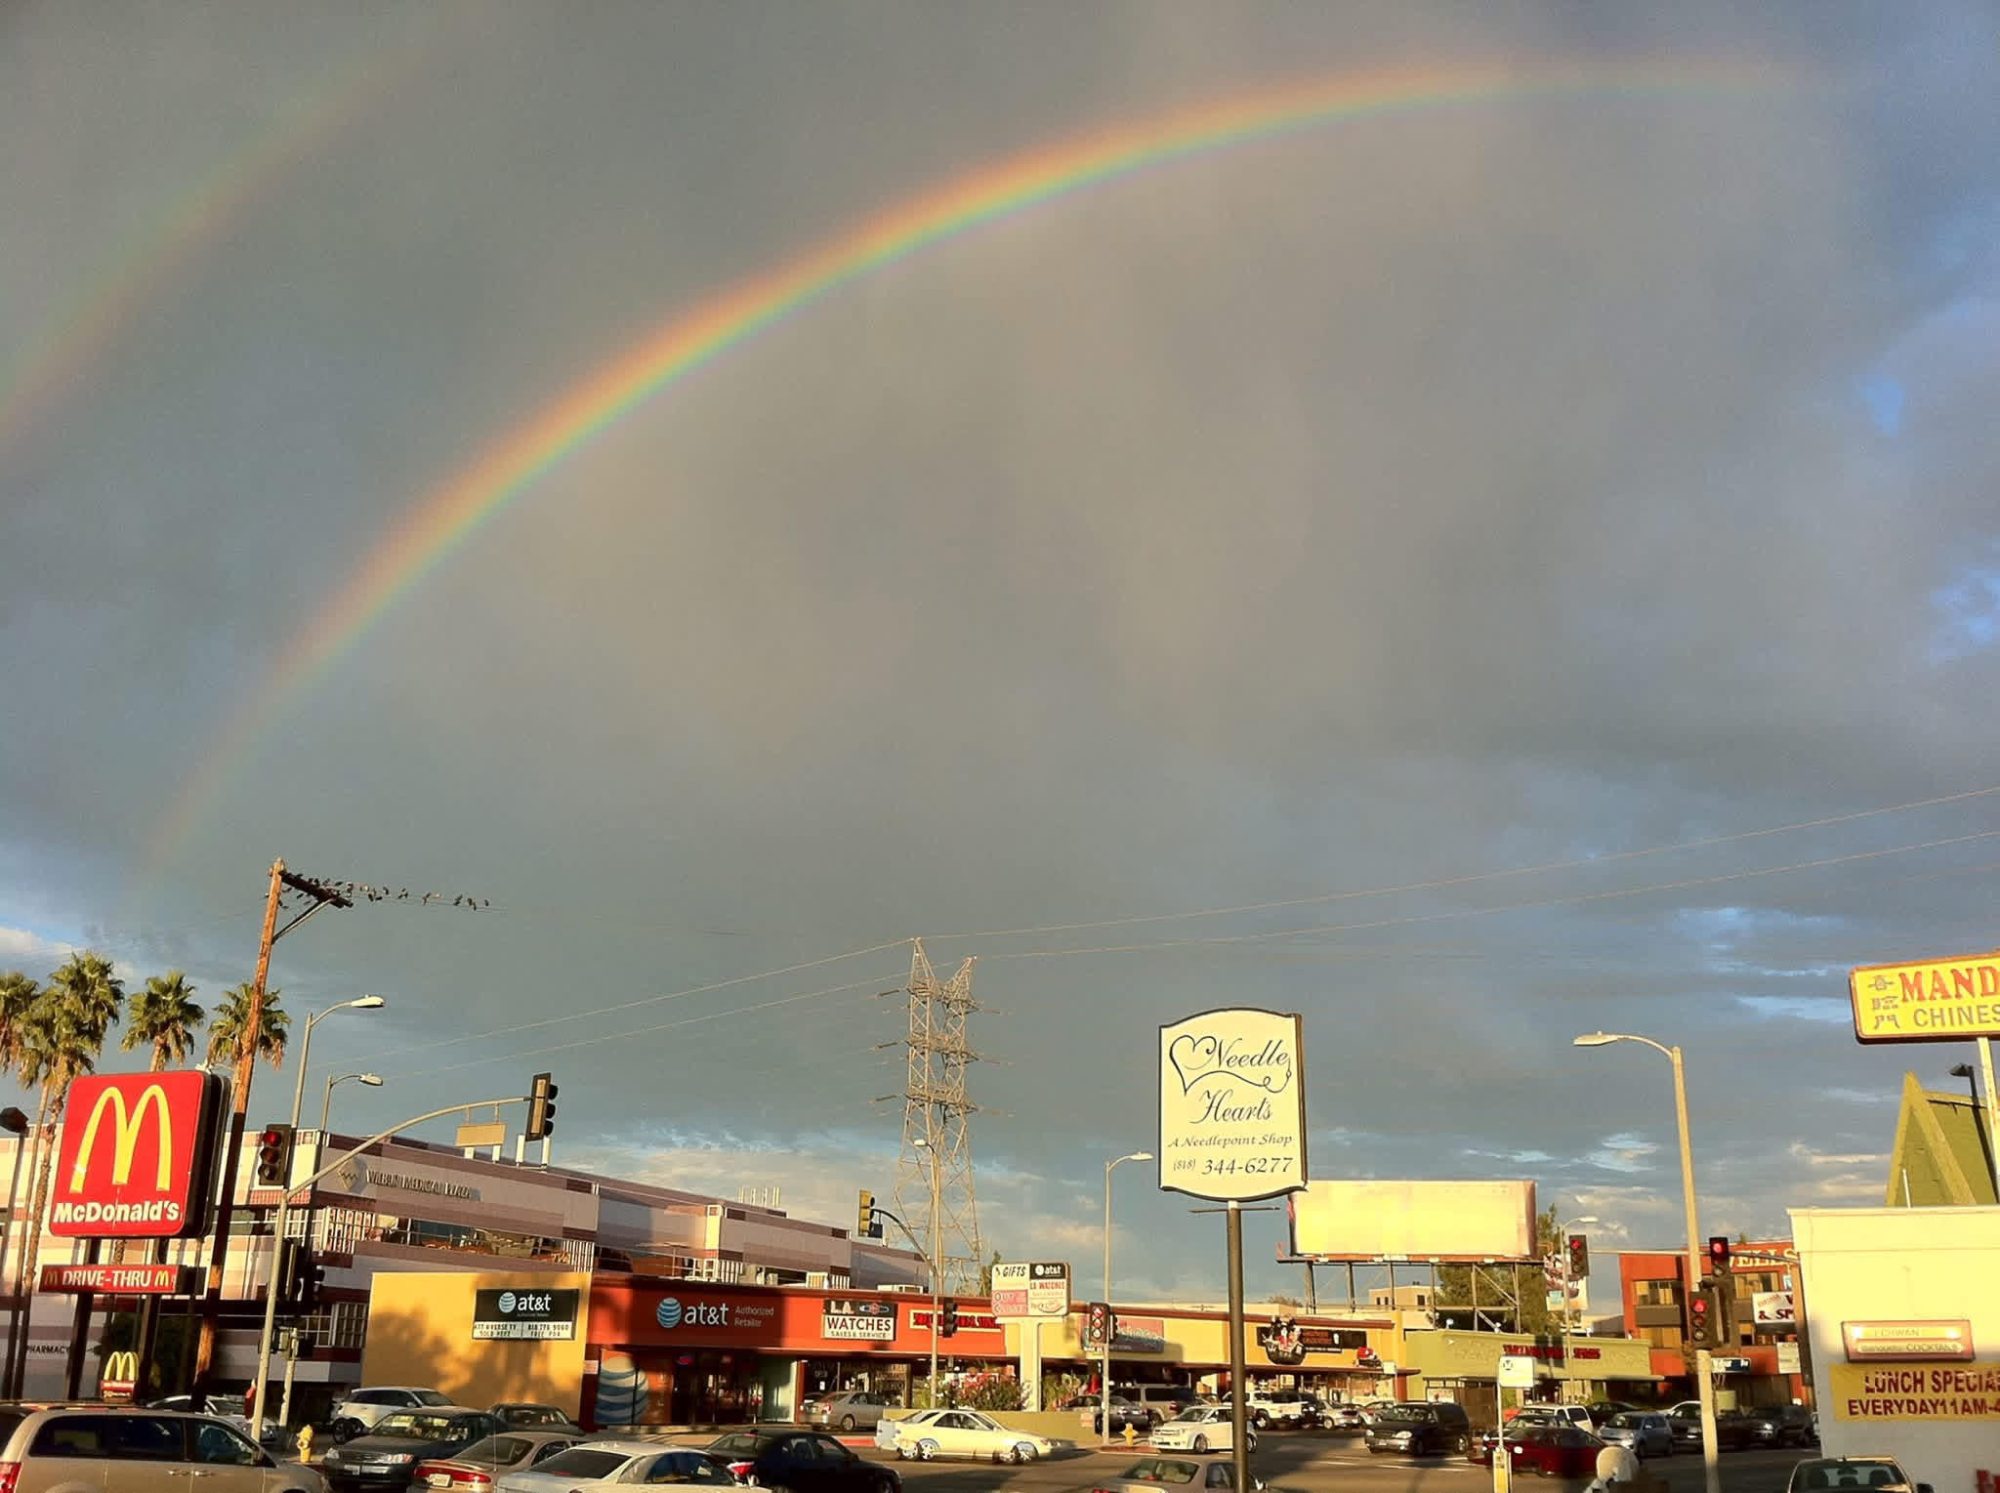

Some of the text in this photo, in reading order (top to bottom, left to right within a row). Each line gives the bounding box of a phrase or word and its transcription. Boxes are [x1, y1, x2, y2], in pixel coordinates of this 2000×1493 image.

[1210, 1037, 1289, 1069] Needle
[1190, 1088, 1273, 1124] Hearts
[1168, 1133, 1293, 1149] A Needlepoint Shop
[1201, 1157, 1294, 1175] 344-6277
[53, 1200, 180, 1223] McDonald's
[62, 1269, 151, 1287] DRIVE-THRU
[1002, 1265, 1026, 1277] GIFTS
[517, 1293, 552, 1311] at&t
[735, 1304, 775, 1317] Authorized
[684, 1301, 729, 1326] at&t
[734, 1317, 763, 1328] Retailer
[827, 1316, 892, 1332] WATCHES
[1864, 1369, 2000, 1394] LUNCH SPECIA
